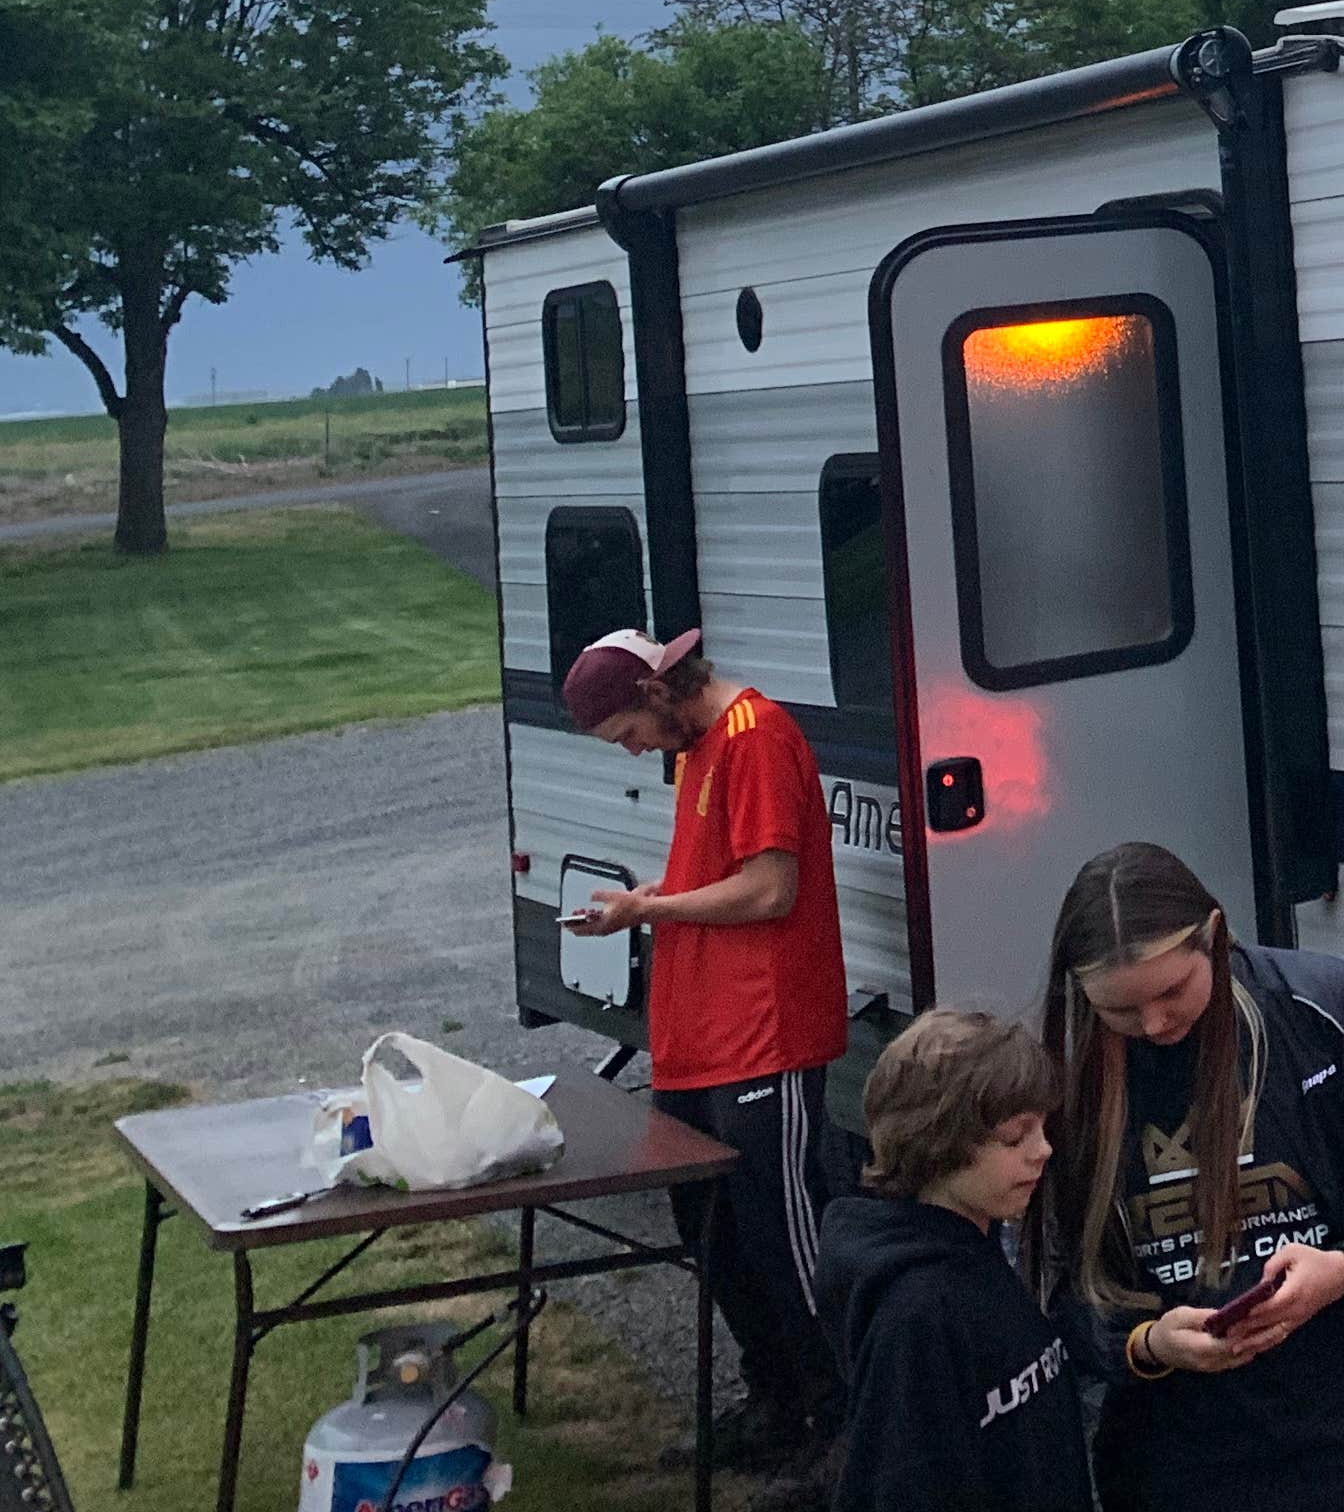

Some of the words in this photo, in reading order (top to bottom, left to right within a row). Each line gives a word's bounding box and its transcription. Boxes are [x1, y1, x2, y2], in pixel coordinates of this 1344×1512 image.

[737, 1086, 774, 1104] adidas
[1255, 1224, 1329, 1257] CAMP
[980, 1361, 1038, 1428] JUST
